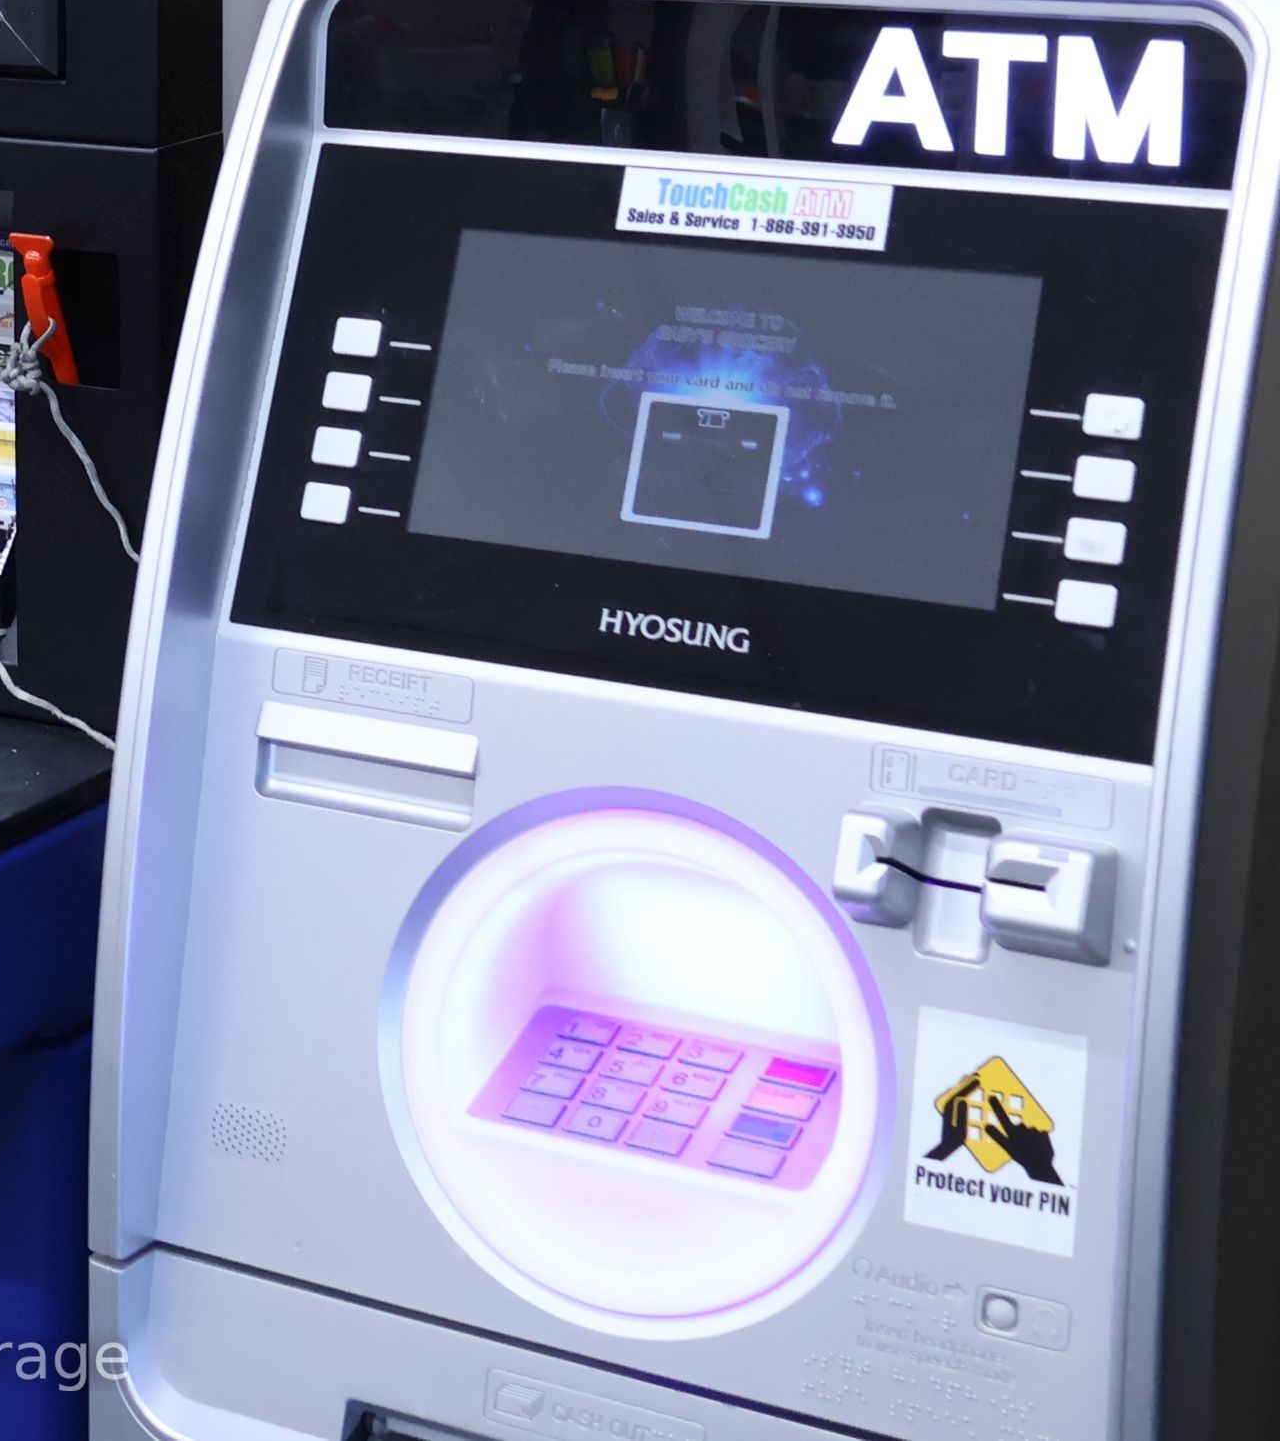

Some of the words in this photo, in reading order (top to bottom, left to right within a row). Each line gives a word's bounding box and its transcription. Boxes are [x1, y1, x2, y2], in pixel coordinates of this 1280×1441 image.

[830, 25, 1187, 168] ATM
[627, 208, 665, 224] Sales
[670, 212, 680, 225] &
[686, 212, 740, 230] Service
[658, 177, 788, 215] TouchCash
[792, 187, 854, 219] ATM
[598, 606, 751, 655] HYOSUNG
[915, 1165, 985, 1198] Protect
[990, 1183, 1033, 1208] your
[1040, 1192, 1070, 1216] PIN
